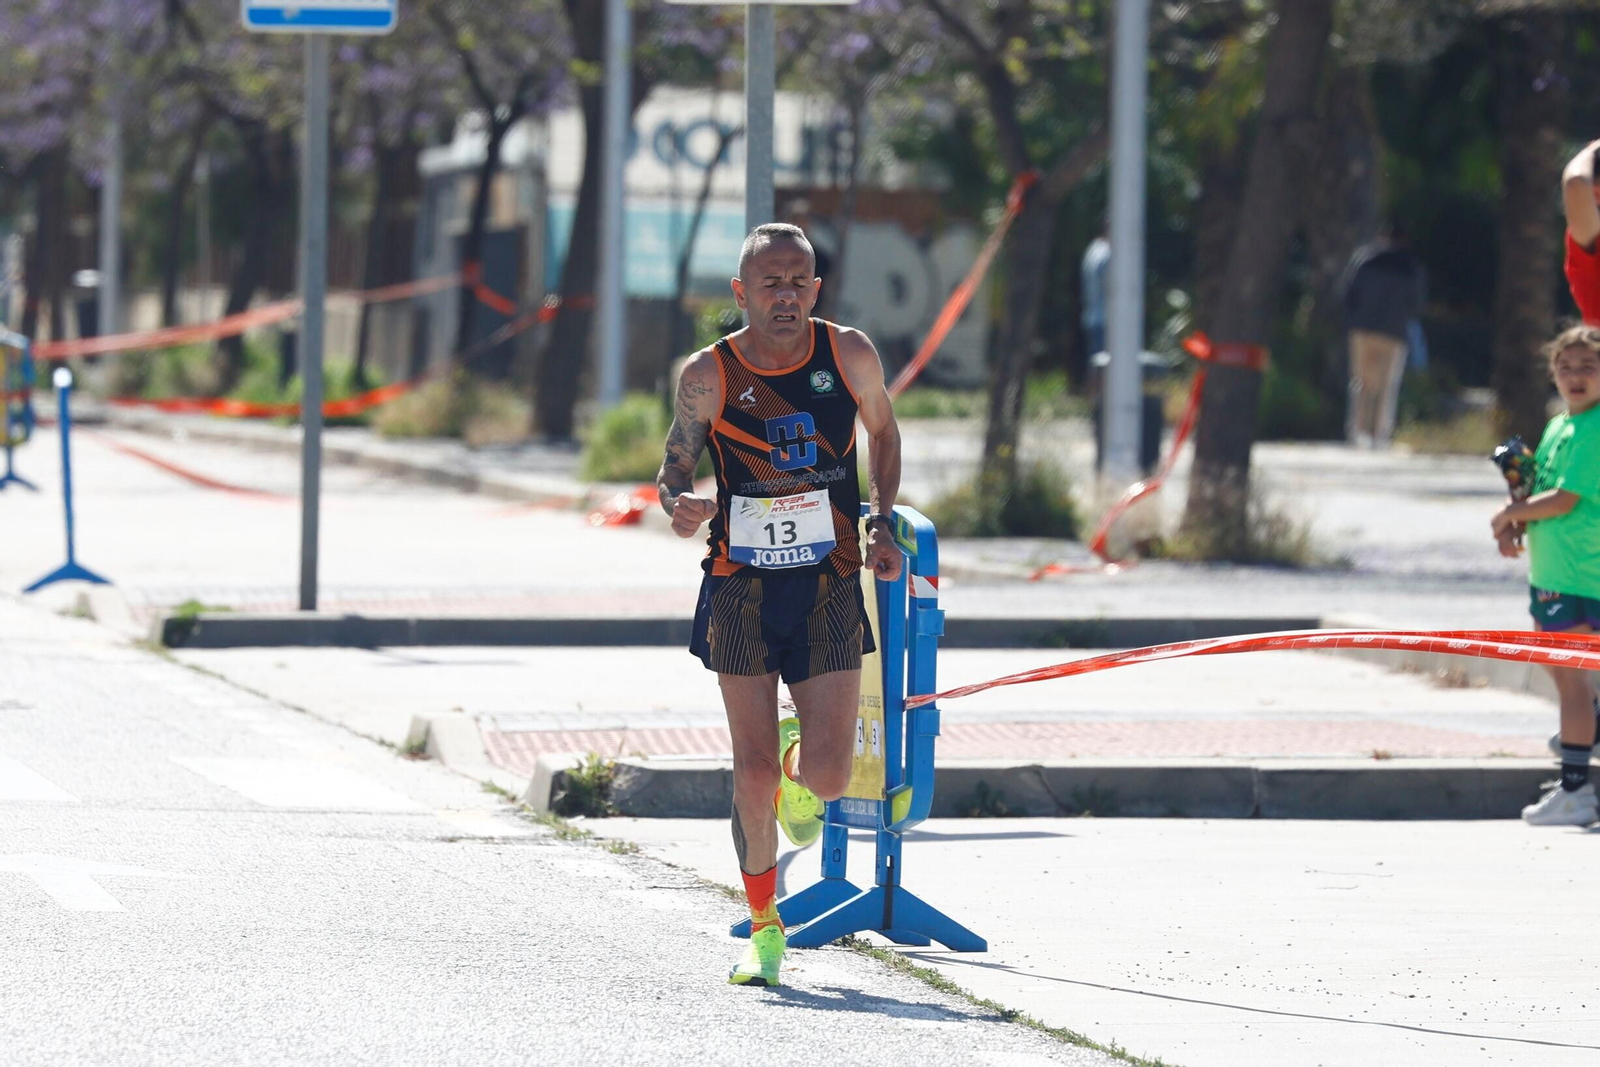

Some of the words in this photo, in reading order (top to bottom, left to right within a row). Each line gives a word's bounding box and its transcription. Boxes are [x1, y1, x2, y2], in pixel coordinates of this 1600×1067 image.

[770, 500, 820, 513] ATLETISMO
[791, 507, 822, 517] RUNNING
[763, 520, 797, 546] 13
